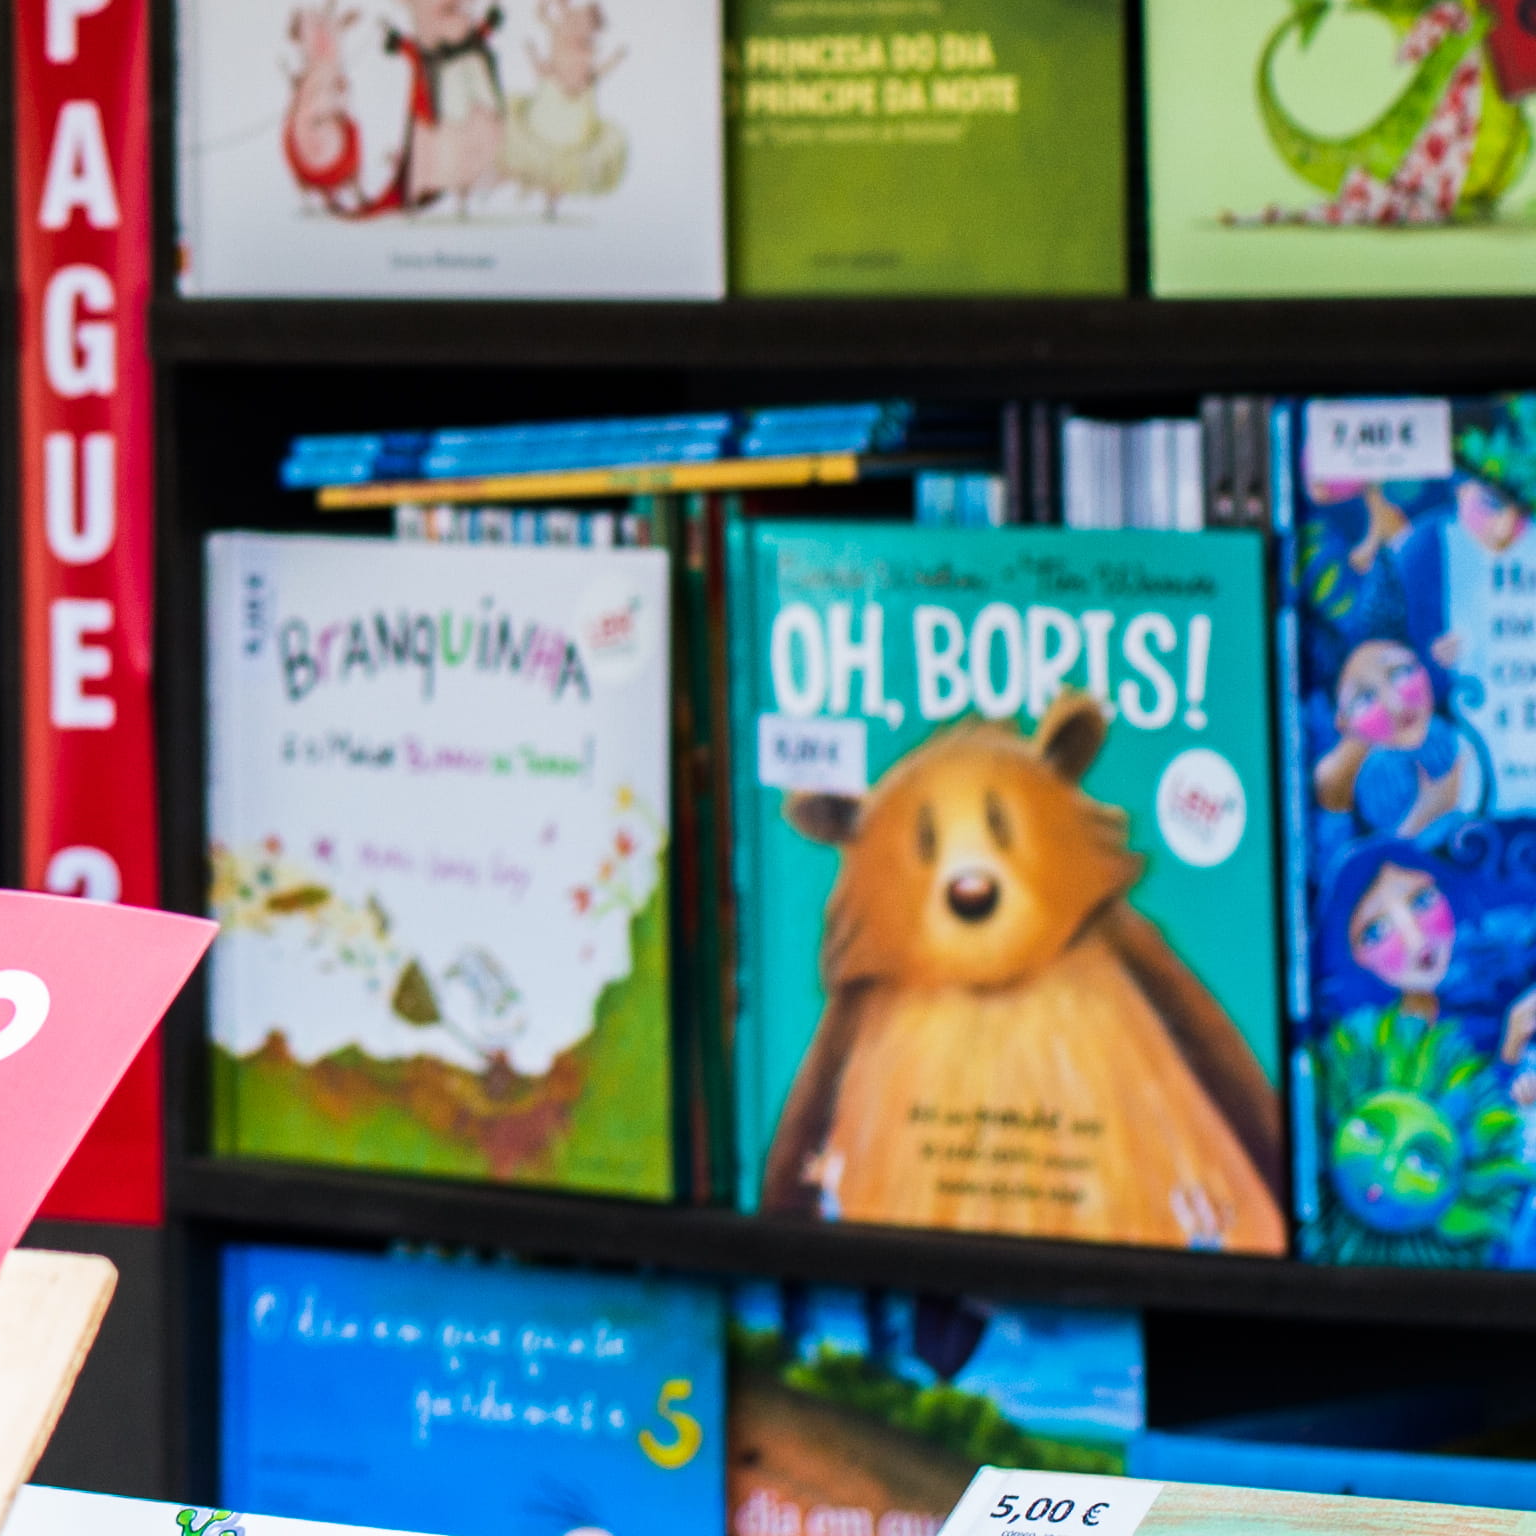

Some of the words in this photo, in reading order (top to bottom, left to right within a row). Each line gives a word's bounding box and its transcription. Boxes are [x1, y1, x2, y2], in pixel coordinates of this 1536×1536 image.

[771, 601, 905, 731] OH,
[912, 601, 1212, 731] BORIS!
[638, 1377, 704, 1471] 5
[989, 1493, 1076, 1525] 5,00
[1081, 1500, 1110, 1527] €
